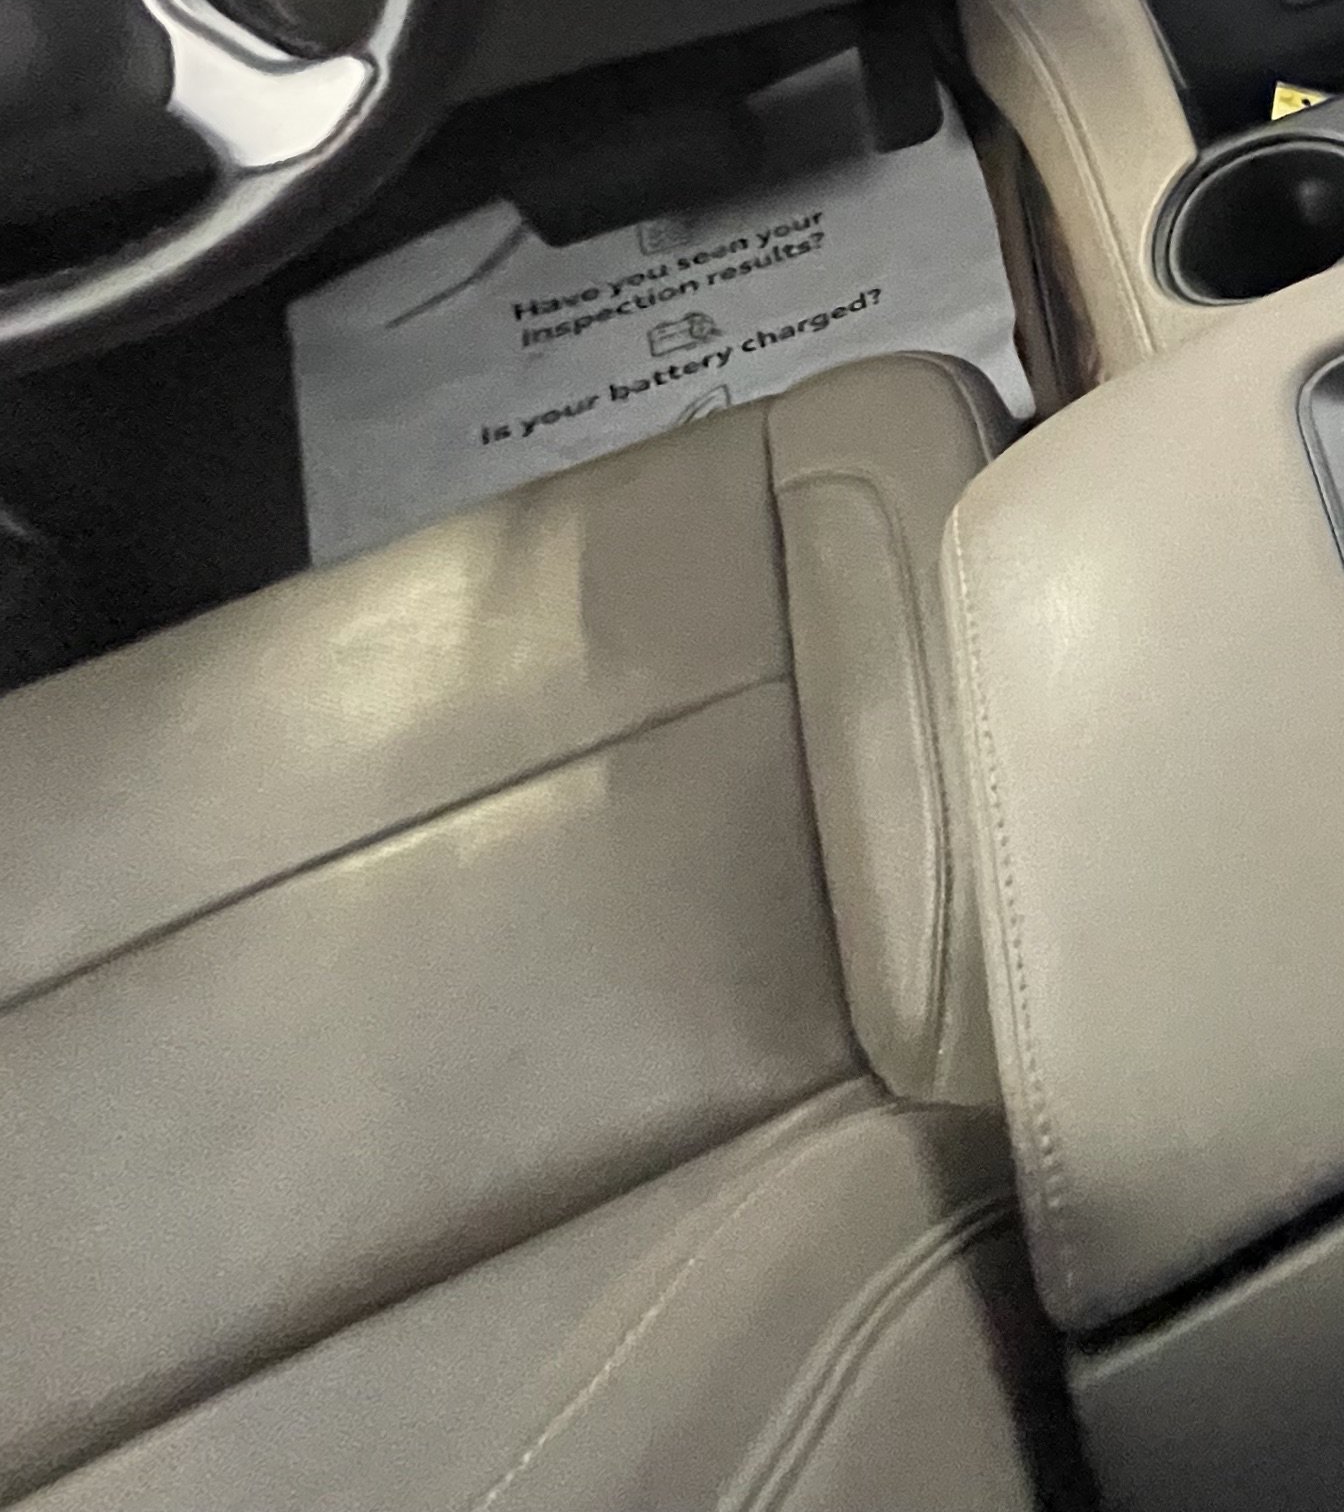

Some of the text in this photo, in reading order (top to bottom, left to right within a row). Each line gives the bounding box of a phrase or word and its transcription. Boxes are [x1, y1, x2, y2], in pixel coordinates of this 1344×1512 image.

[512, 210, 824, 321] Have you seen your
[520, 231, 826, 347] inspection results?
[481, 287, 882, 445] Is your battery charged?
